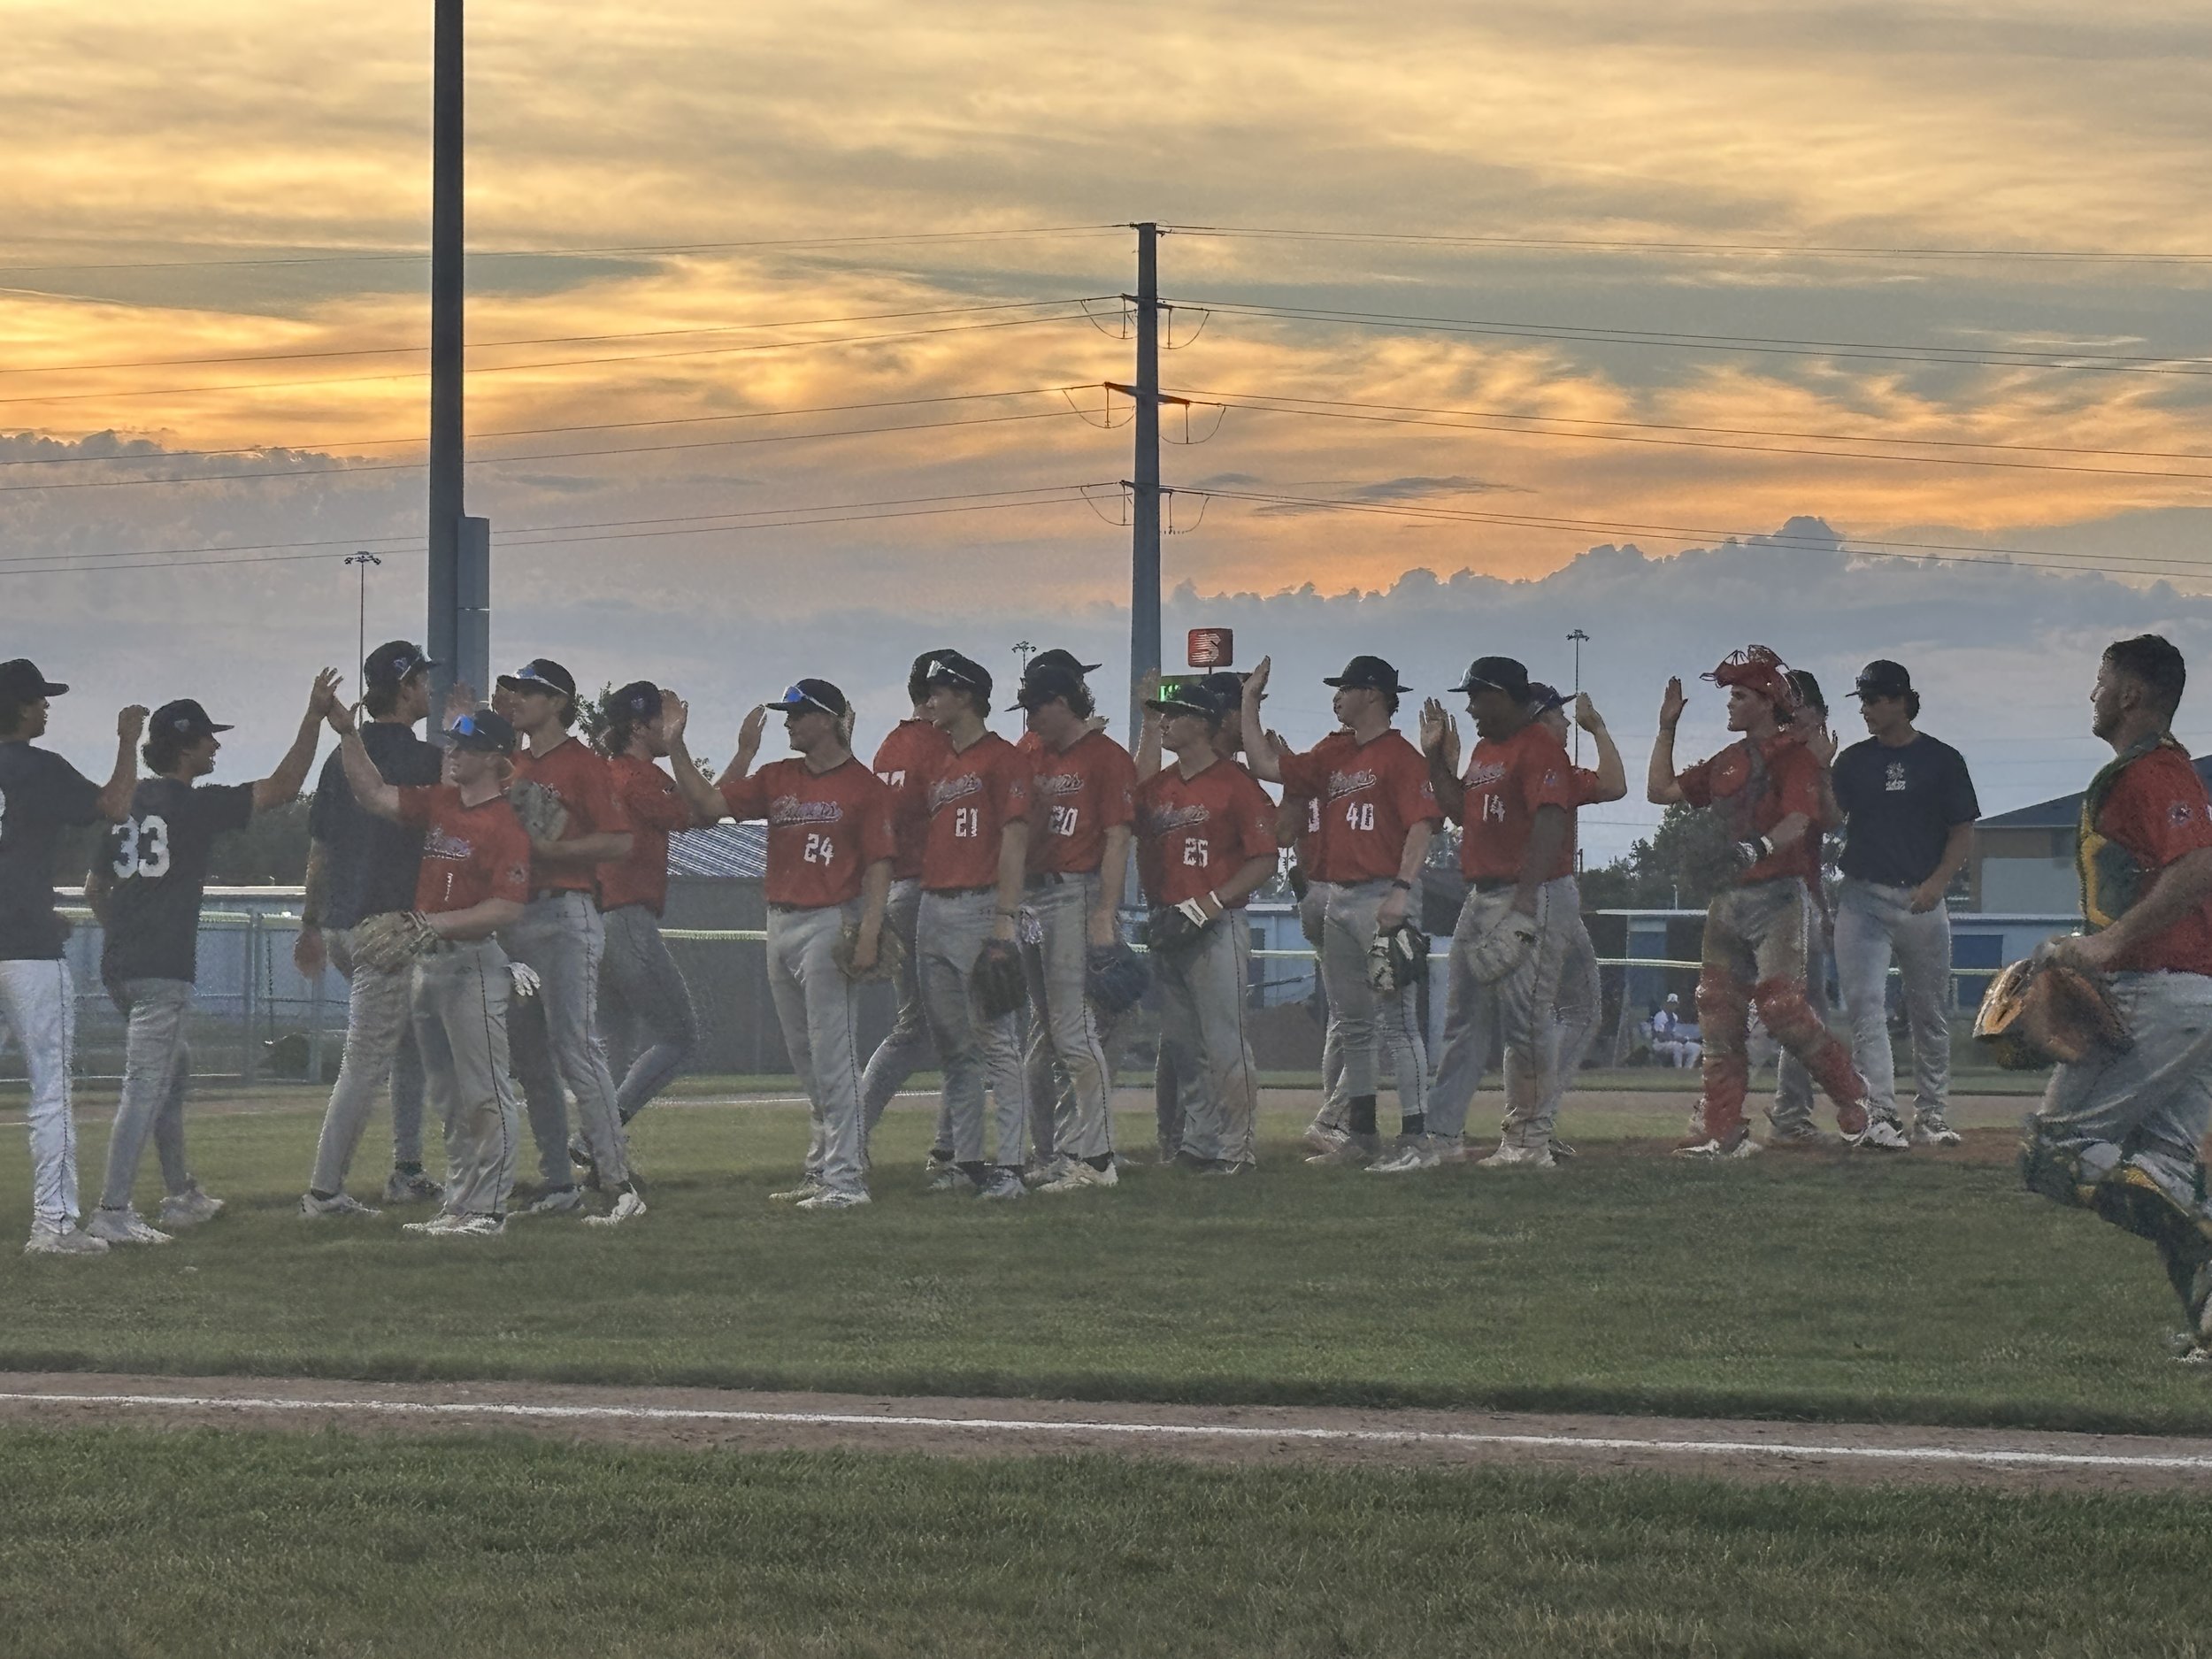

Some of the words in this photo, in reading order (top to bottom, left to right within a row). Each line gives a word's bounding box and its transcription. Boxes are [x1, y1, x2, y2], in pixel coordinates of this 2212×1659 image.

[956, 808, 978, 837] 21
[1049, 806, 1079, 837] 20
[1347, 803, 1374, 830] 40
[1483, 794, 1505, 822] 14
[111, 814, 170, 879] 33
[803, 833, 834, 866] 24
[1183, 837, 1209, 868] 25
